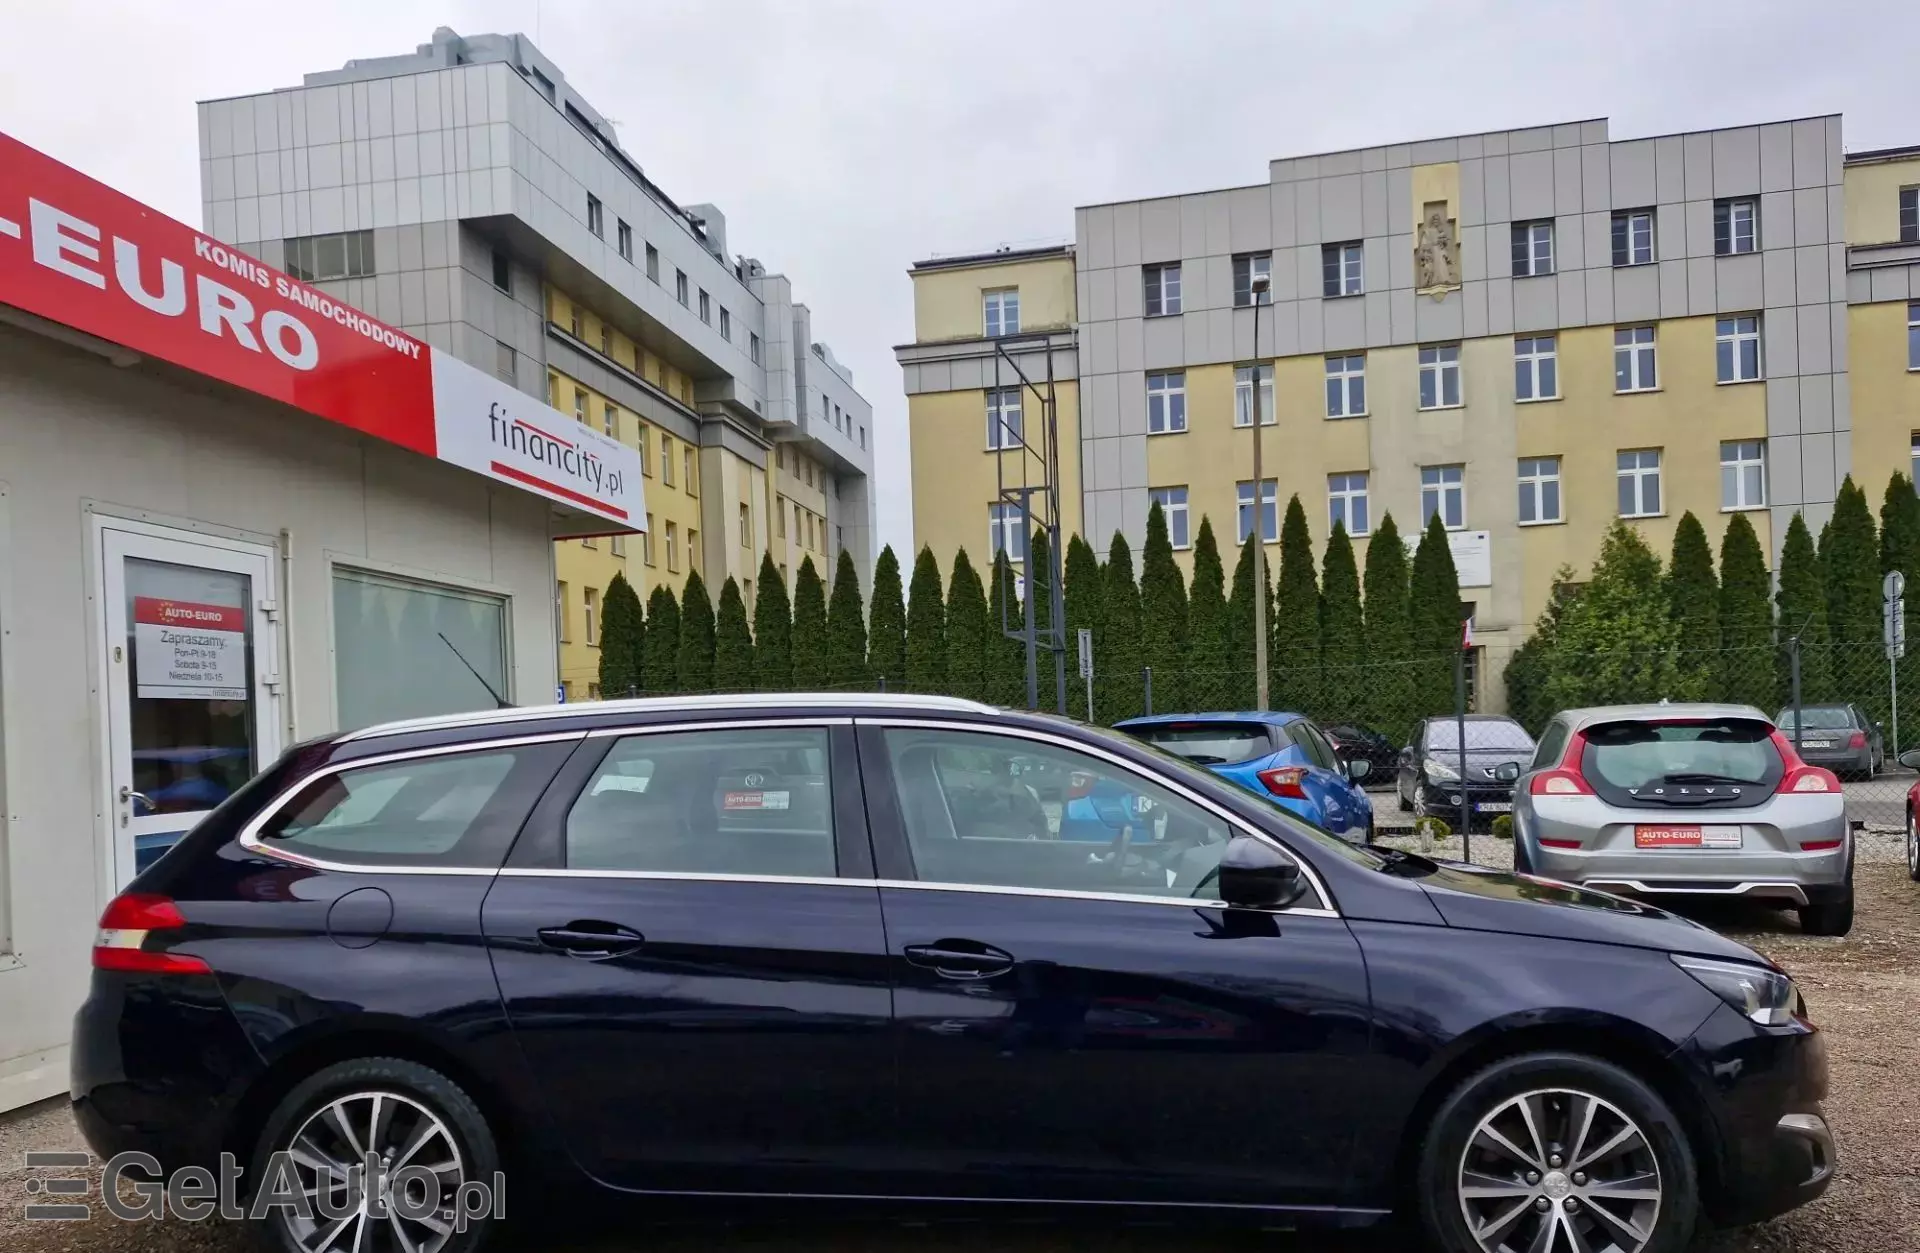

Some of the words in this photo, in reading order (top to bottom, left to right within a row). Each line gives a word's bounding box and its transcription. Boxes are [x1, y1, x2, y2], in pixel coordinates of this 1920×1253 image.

[194, 236, 271, 288] KOMIS
[276, 278, 421, 360] SAMOCHODOWY
[488, 401, 624, 497] financity.pl
[164, 607, 223, 622] AUTO-EURO
[1627, 787, 1741, 795] VOLVO
[1641, 831, 1701, 840] AUTO-EURO
